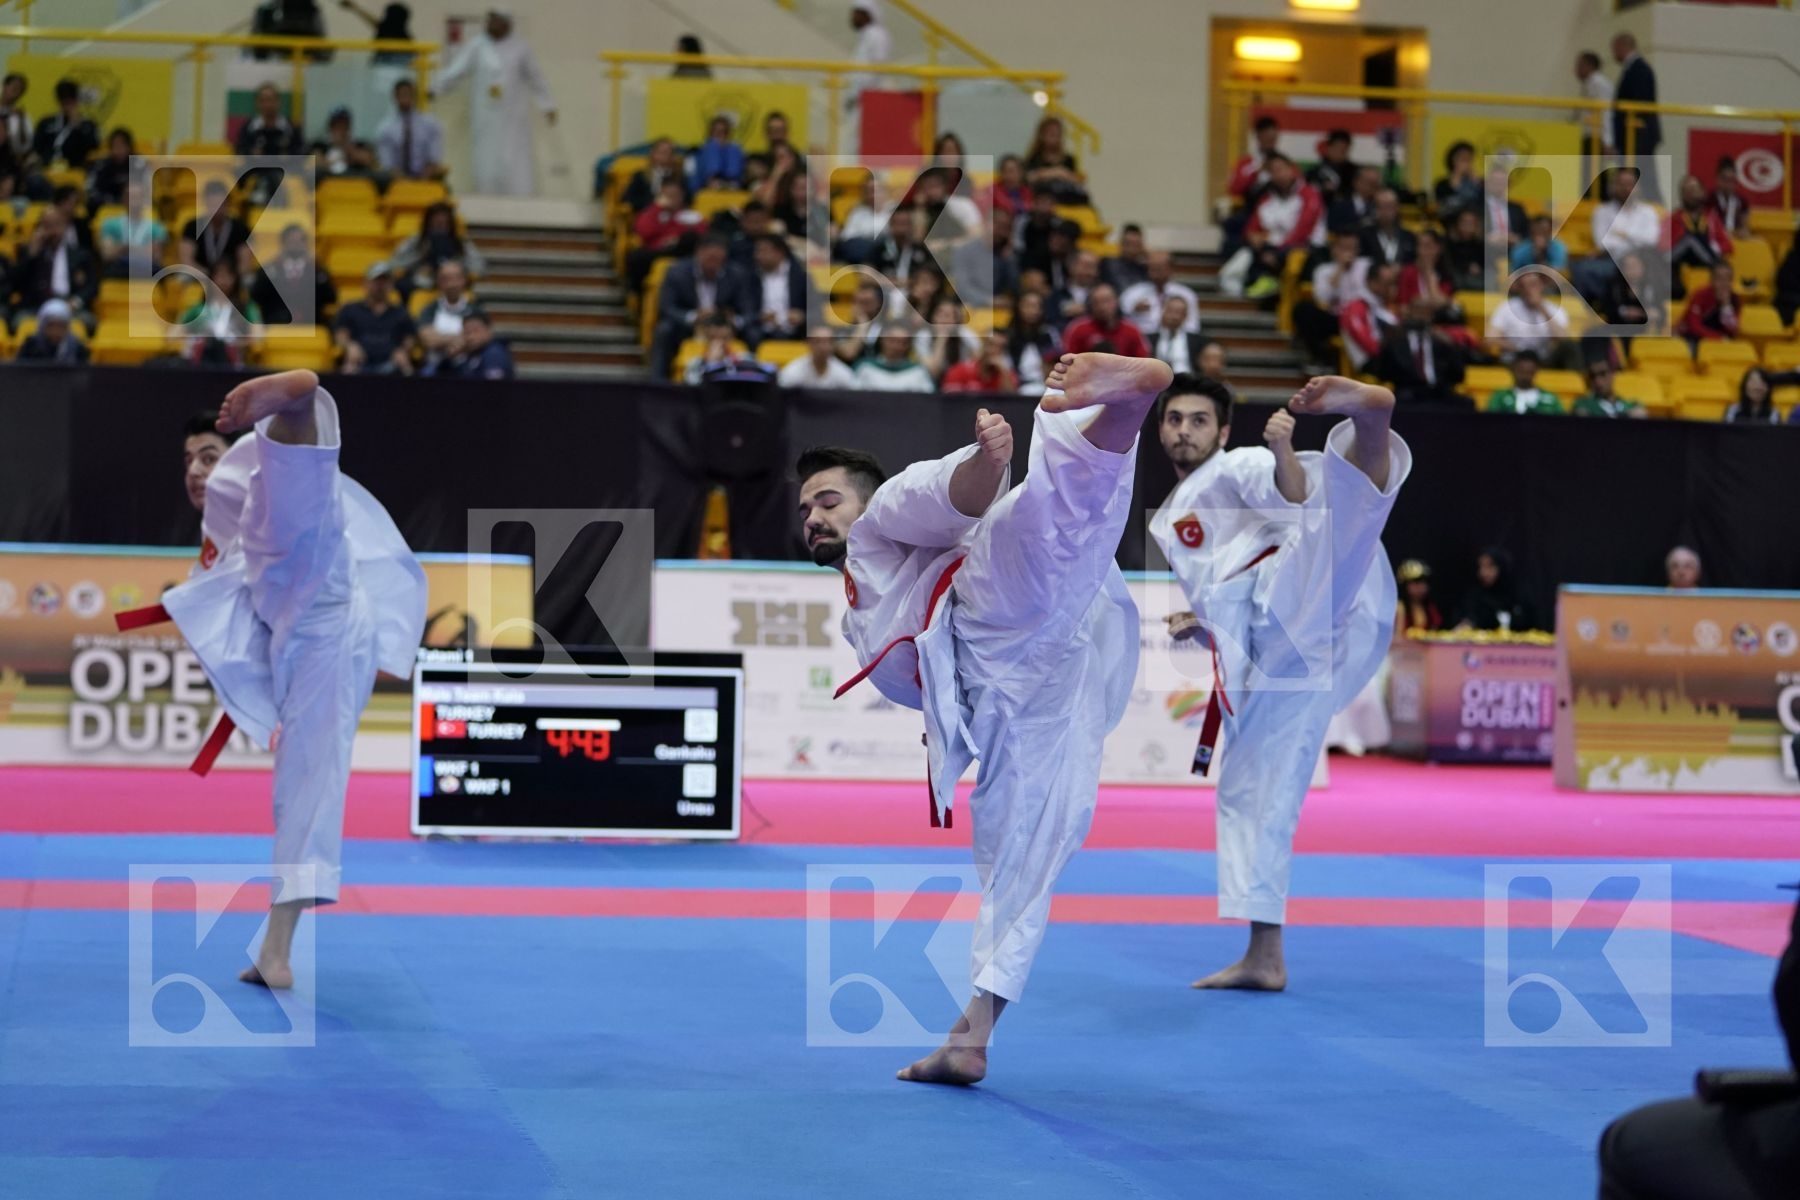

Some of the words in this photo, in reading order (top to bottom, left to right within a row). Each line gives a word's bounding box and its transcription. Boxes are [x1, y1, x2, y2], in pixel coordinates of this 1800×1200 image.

[70, 649, 211, 703] OPE
[1462, 679, 1540, 704] OPEN
[436, 704, 496, 720] TURKEY
[1461, 703, 1540, 729] DUBAI
[467, 722, 527, 739] TURKEY
[434, 760, 469, 777] WKF
[470, 761, 480, 777] 1
[464, 778, 500, 795] WKF
[501, 778, 511, 795] 1
